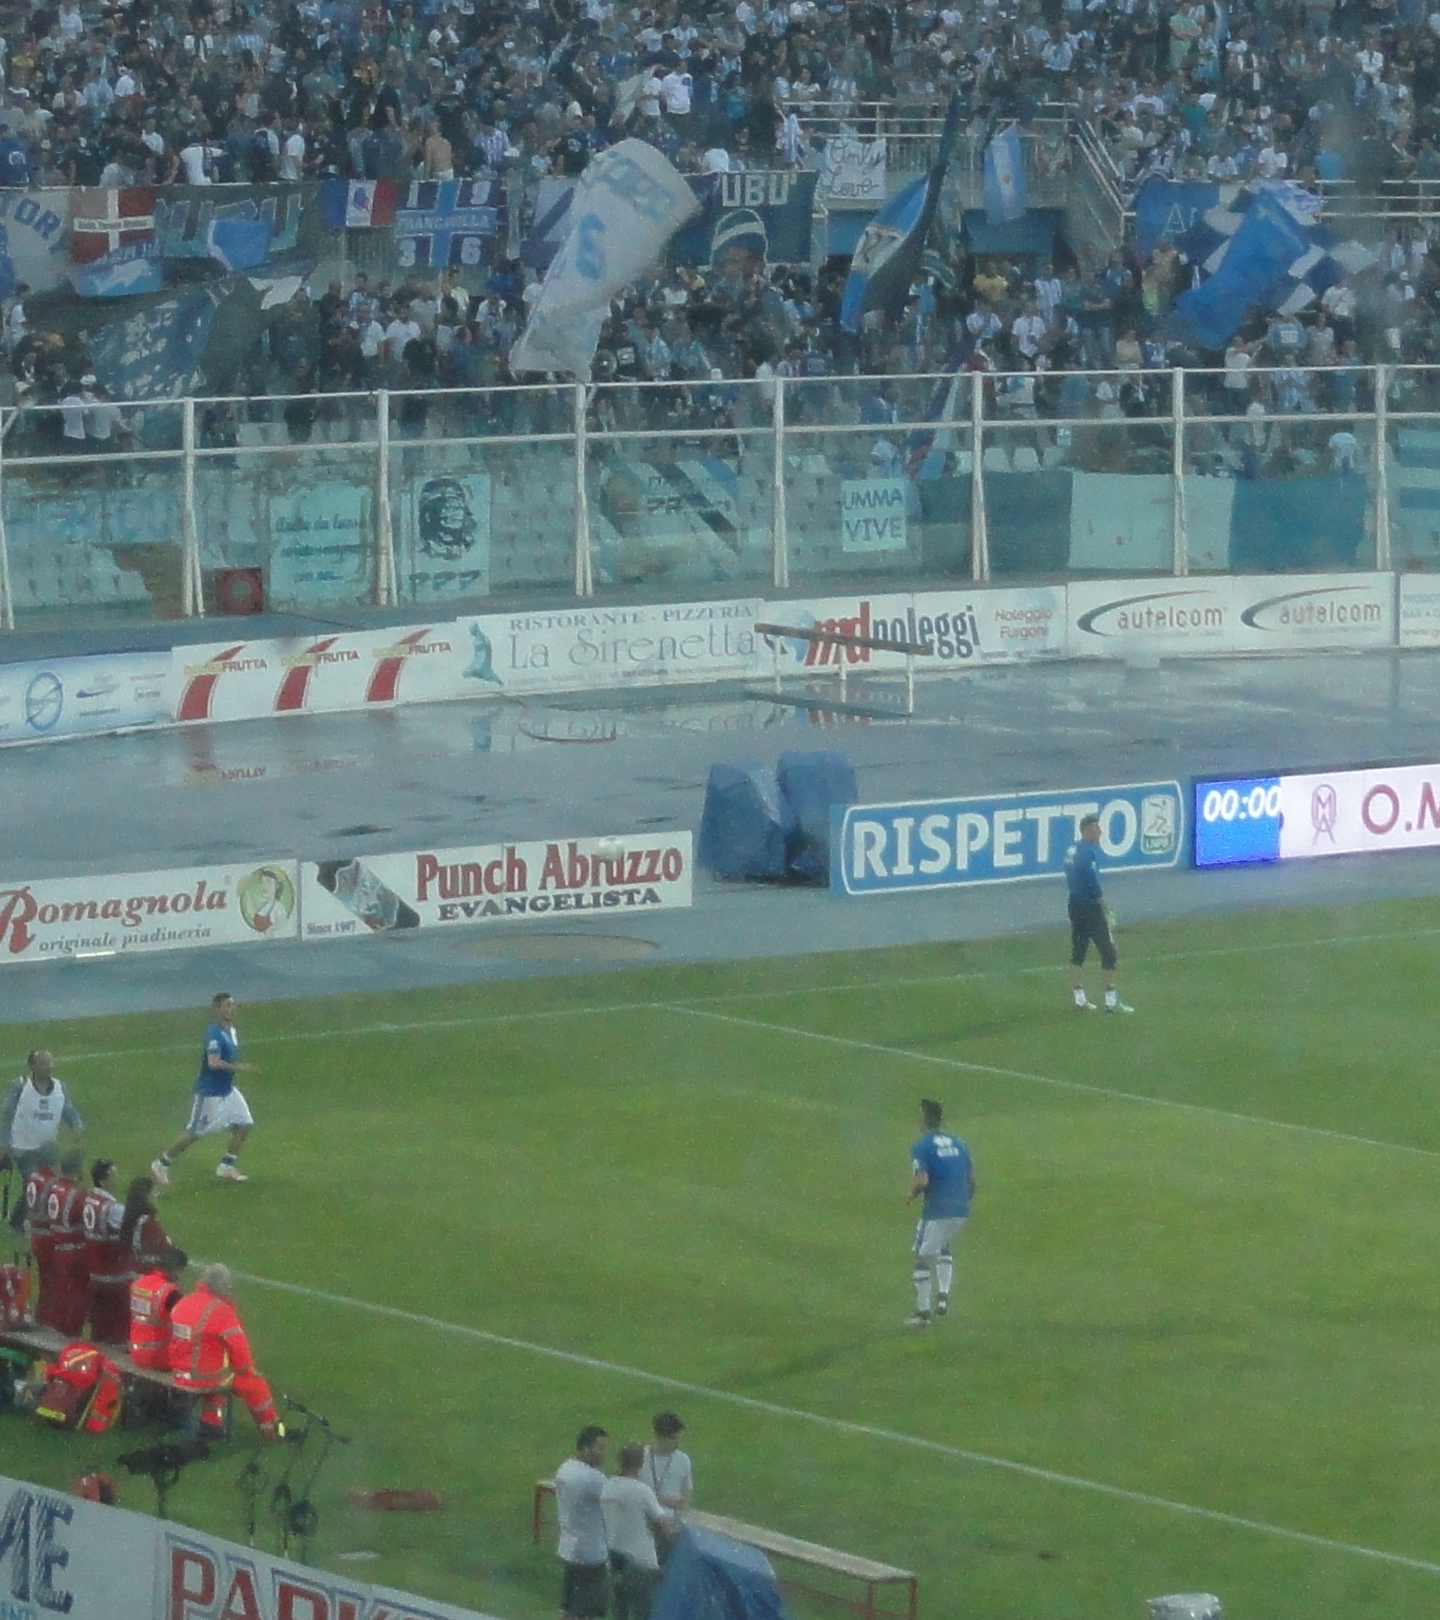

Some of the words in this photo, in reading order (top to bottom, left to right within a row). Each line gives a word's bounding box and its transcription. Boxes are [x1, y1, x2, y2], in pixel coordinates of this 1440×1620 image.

[844, 516, 903, 542] VIVE
[510, 609, 641, 632] RISTORANTE
[994, 606, 1052, 622] Noleggio
[1117, 605, 1223, 631] autelcom
[1279, 601, 1382, 626] autelcom
[510, 634, 549, 670] La
[568, 623, 757, 667] Sirenetta
[1203, 784, 1283, 823] 00:00
[853, 798, 1137, 879] RISPETTO
[416, 846, 527, 903] Punch
[539, 841, 684, 891] Abruzzo
[437, 887, 662, 922] EVANGELISTA
[39, 933, 117, 955] originale
[122, 924, 212, 950] piadineria
